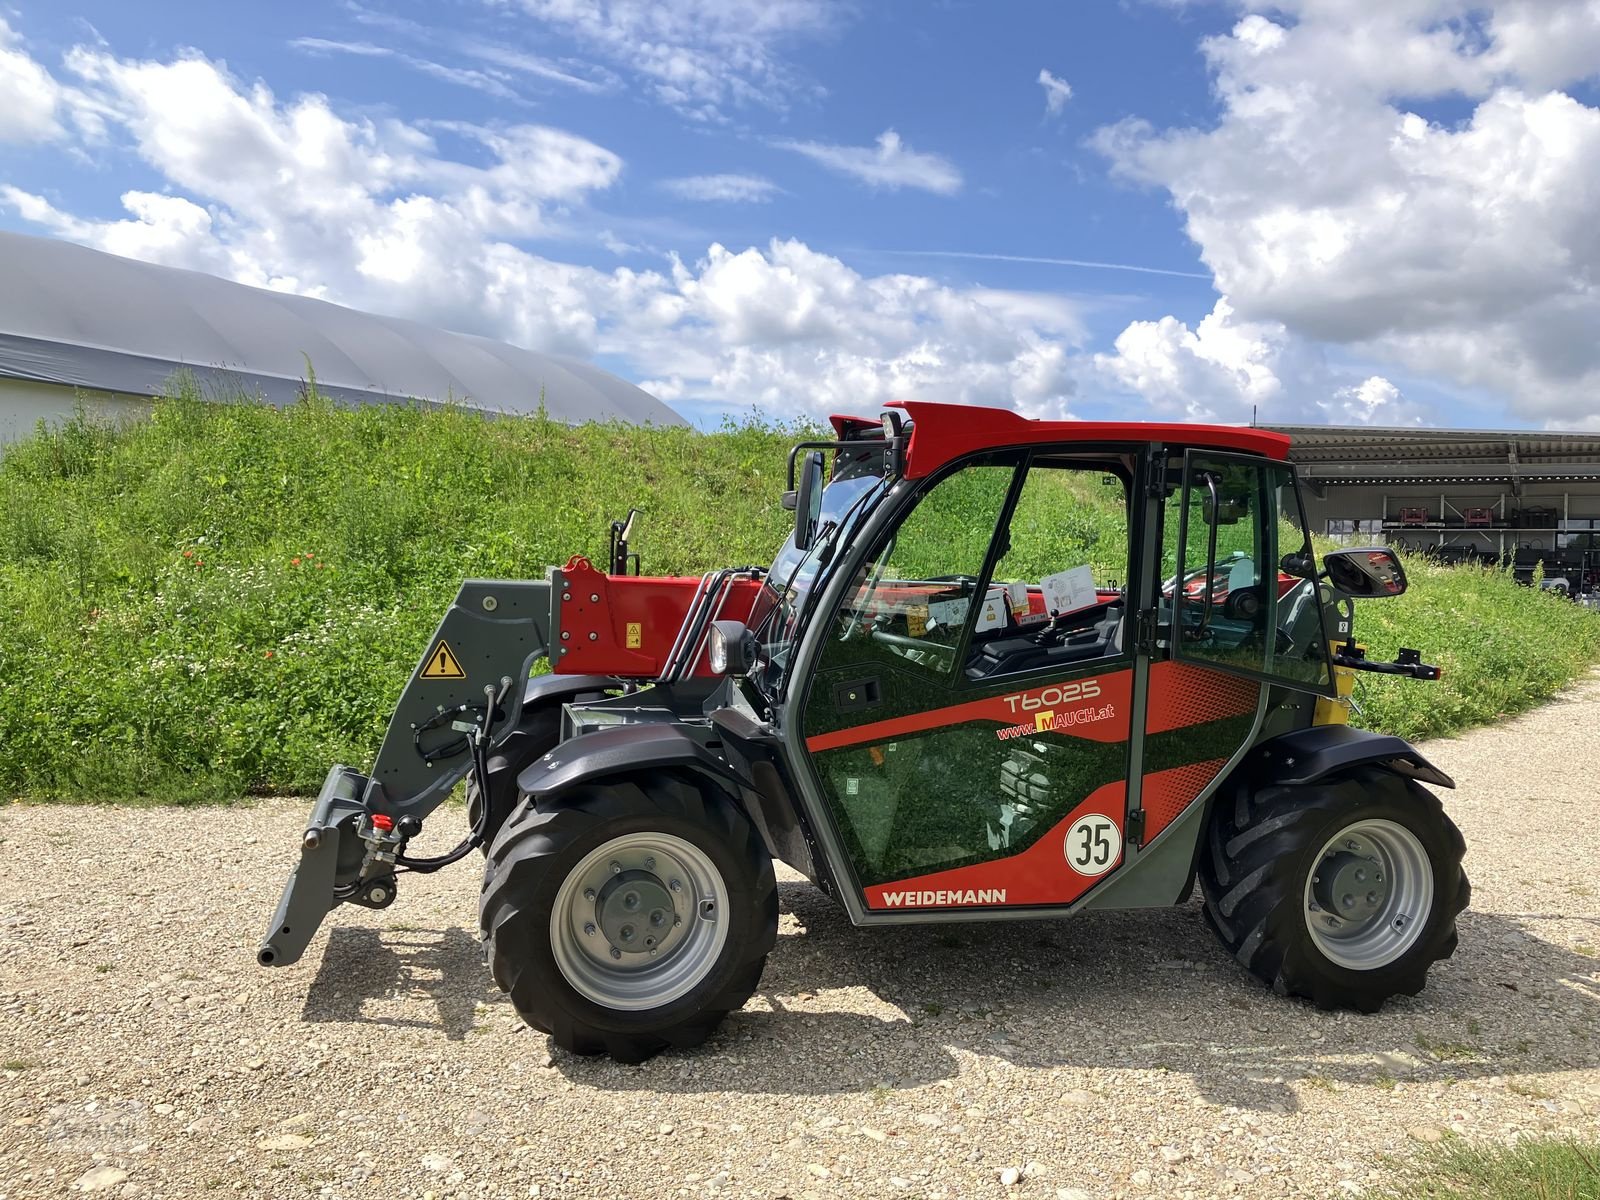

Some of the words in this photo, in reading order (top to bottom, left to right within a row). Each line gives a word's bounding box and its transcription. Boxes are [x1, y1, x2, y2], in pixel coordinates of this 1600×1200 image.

[1003, 679, 1101, 713] T6025
[996, 703, 1115, 741] www.MAUCH.at
[1075, 823, 1111, 866] 35
[882, 889, 1006, 906] WEIDEMANN
